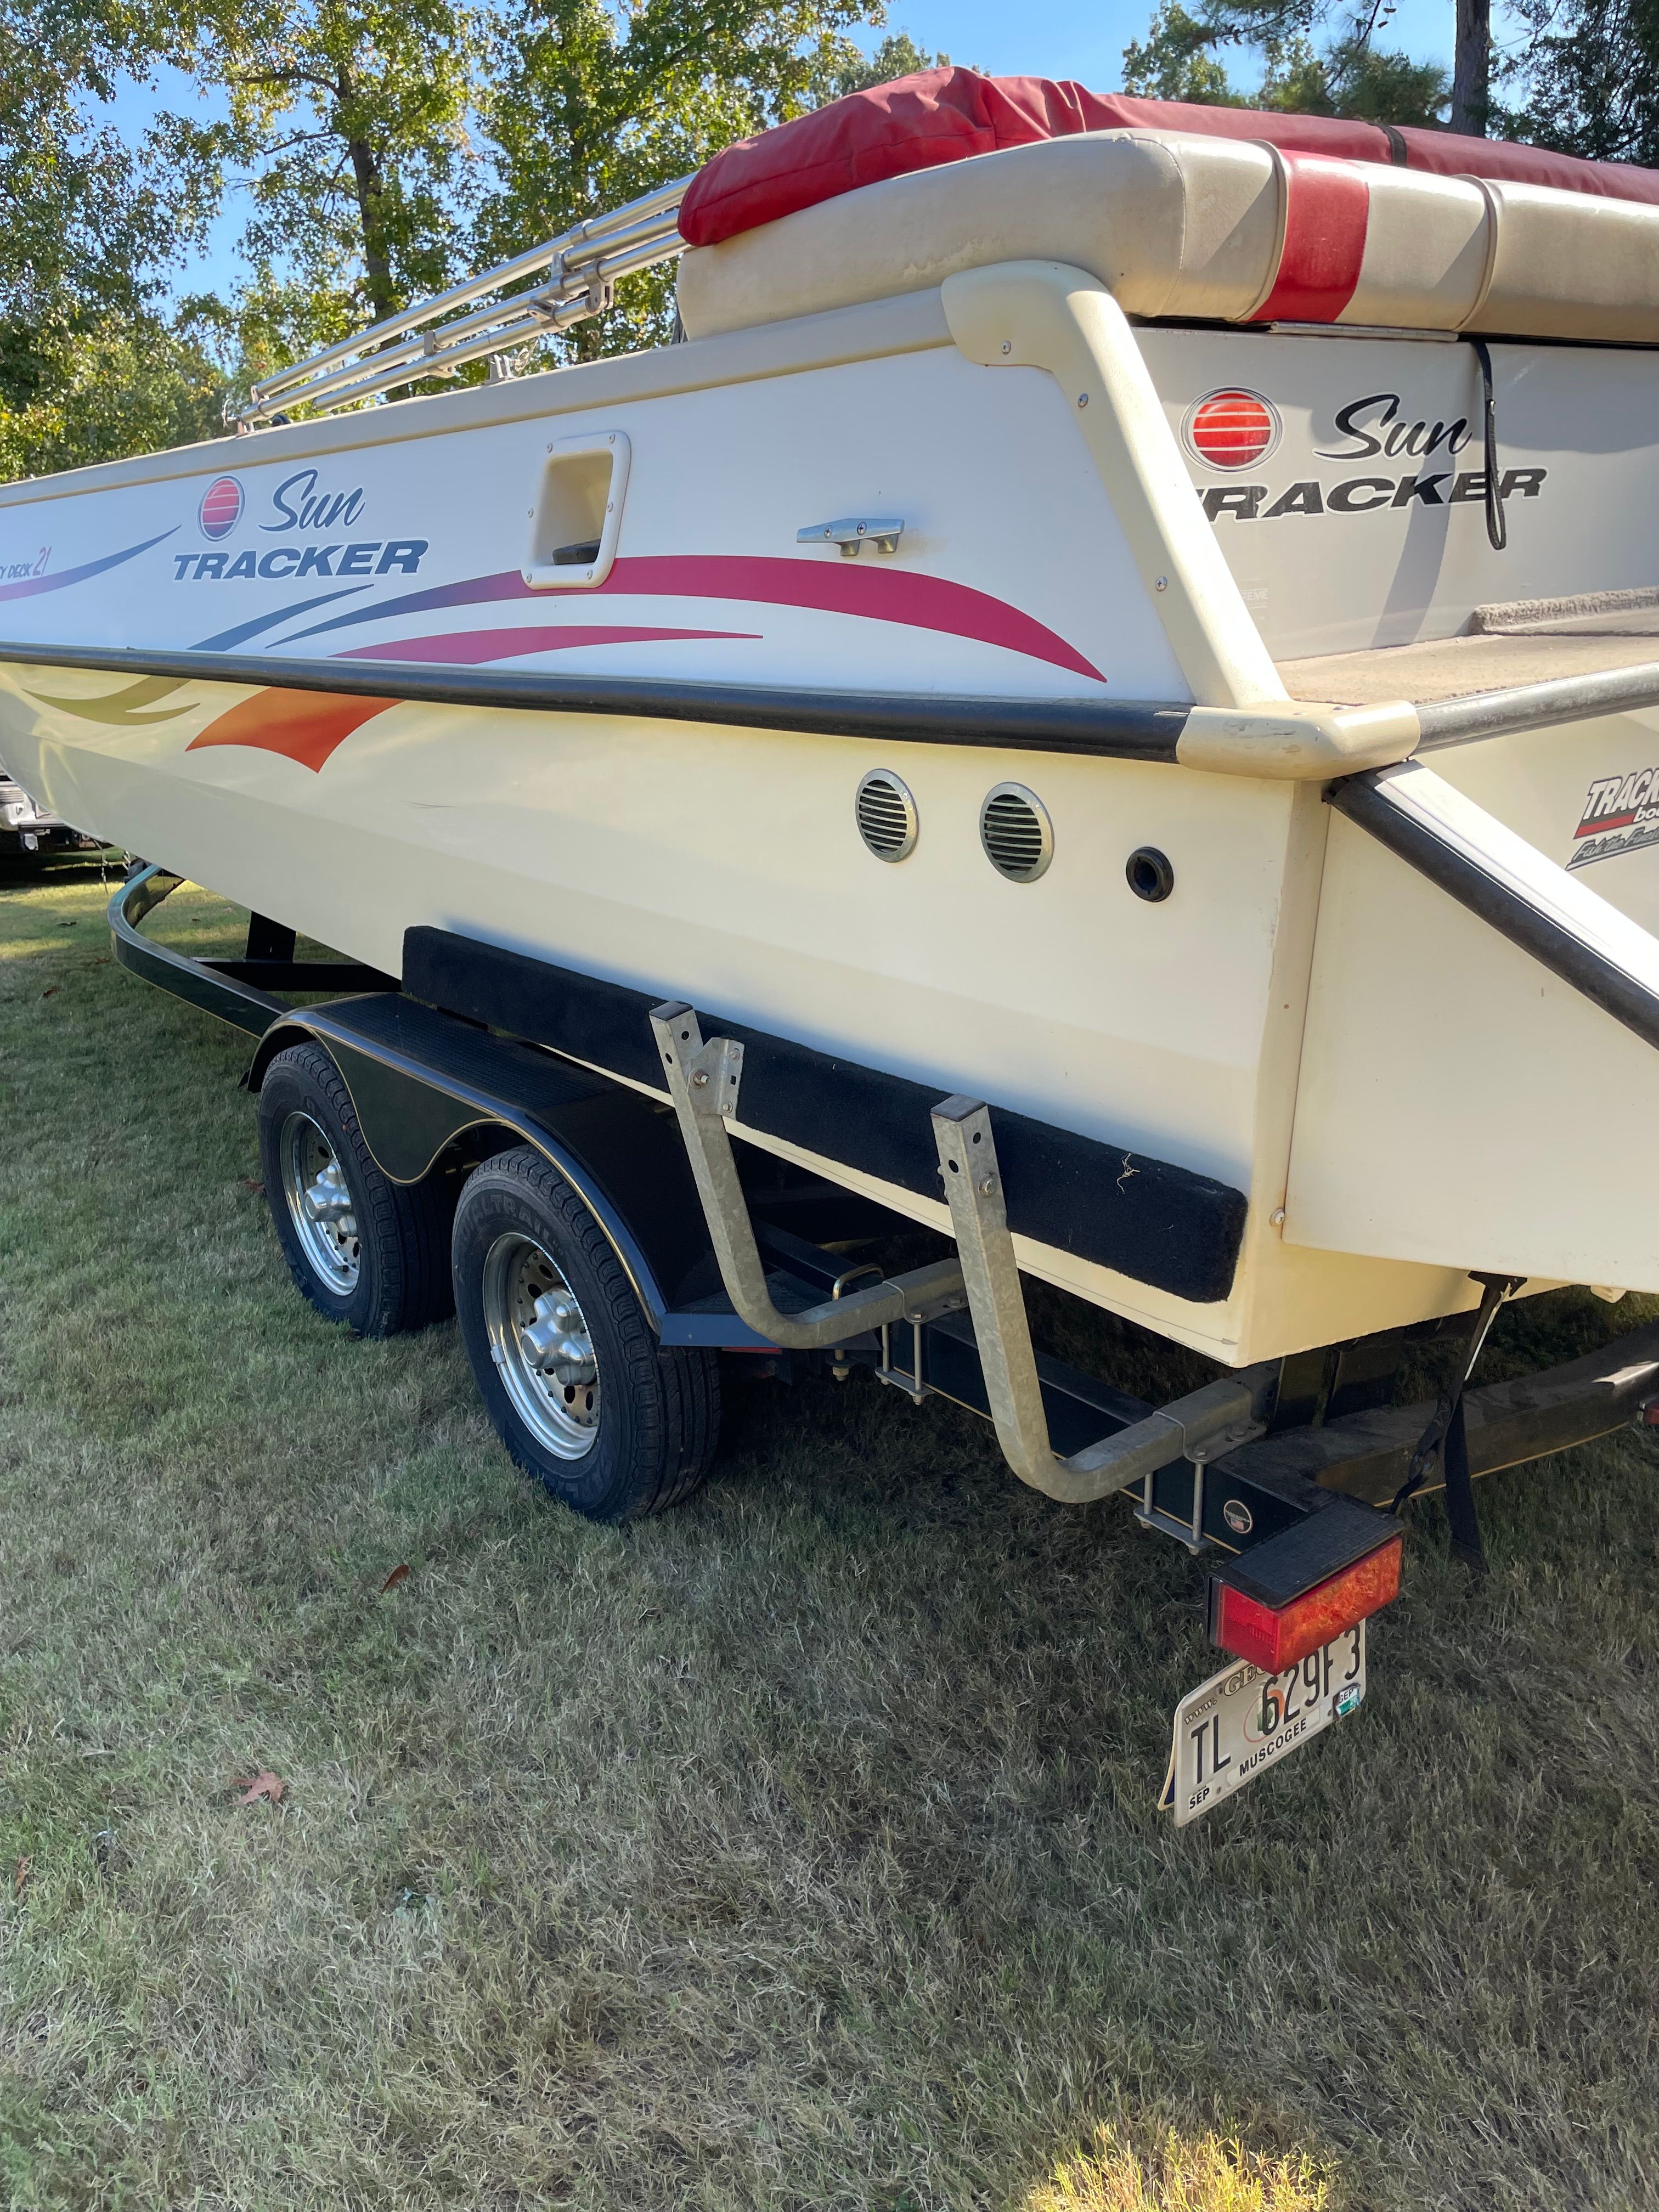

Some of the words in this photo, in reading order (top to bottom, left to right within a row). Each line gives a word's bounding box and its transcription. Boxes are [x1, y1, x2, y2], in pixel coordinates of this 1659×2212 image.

[1312, 394, 1472, 459] Sun
[258, 469, 365, 532] Sun
[1195, 467, 1547, 522] RACKER
[8, 563, 33, 579] DECK
[173, 539, 428, 580] TRACKER
[1583, 768, 1659, 821] TRACK
[1191, 1714, 1231, 1785] TL
[1240, 1718, 1307, 1777] MUSCOGEE
[1189, 1787, 1210, 1809] SEP
